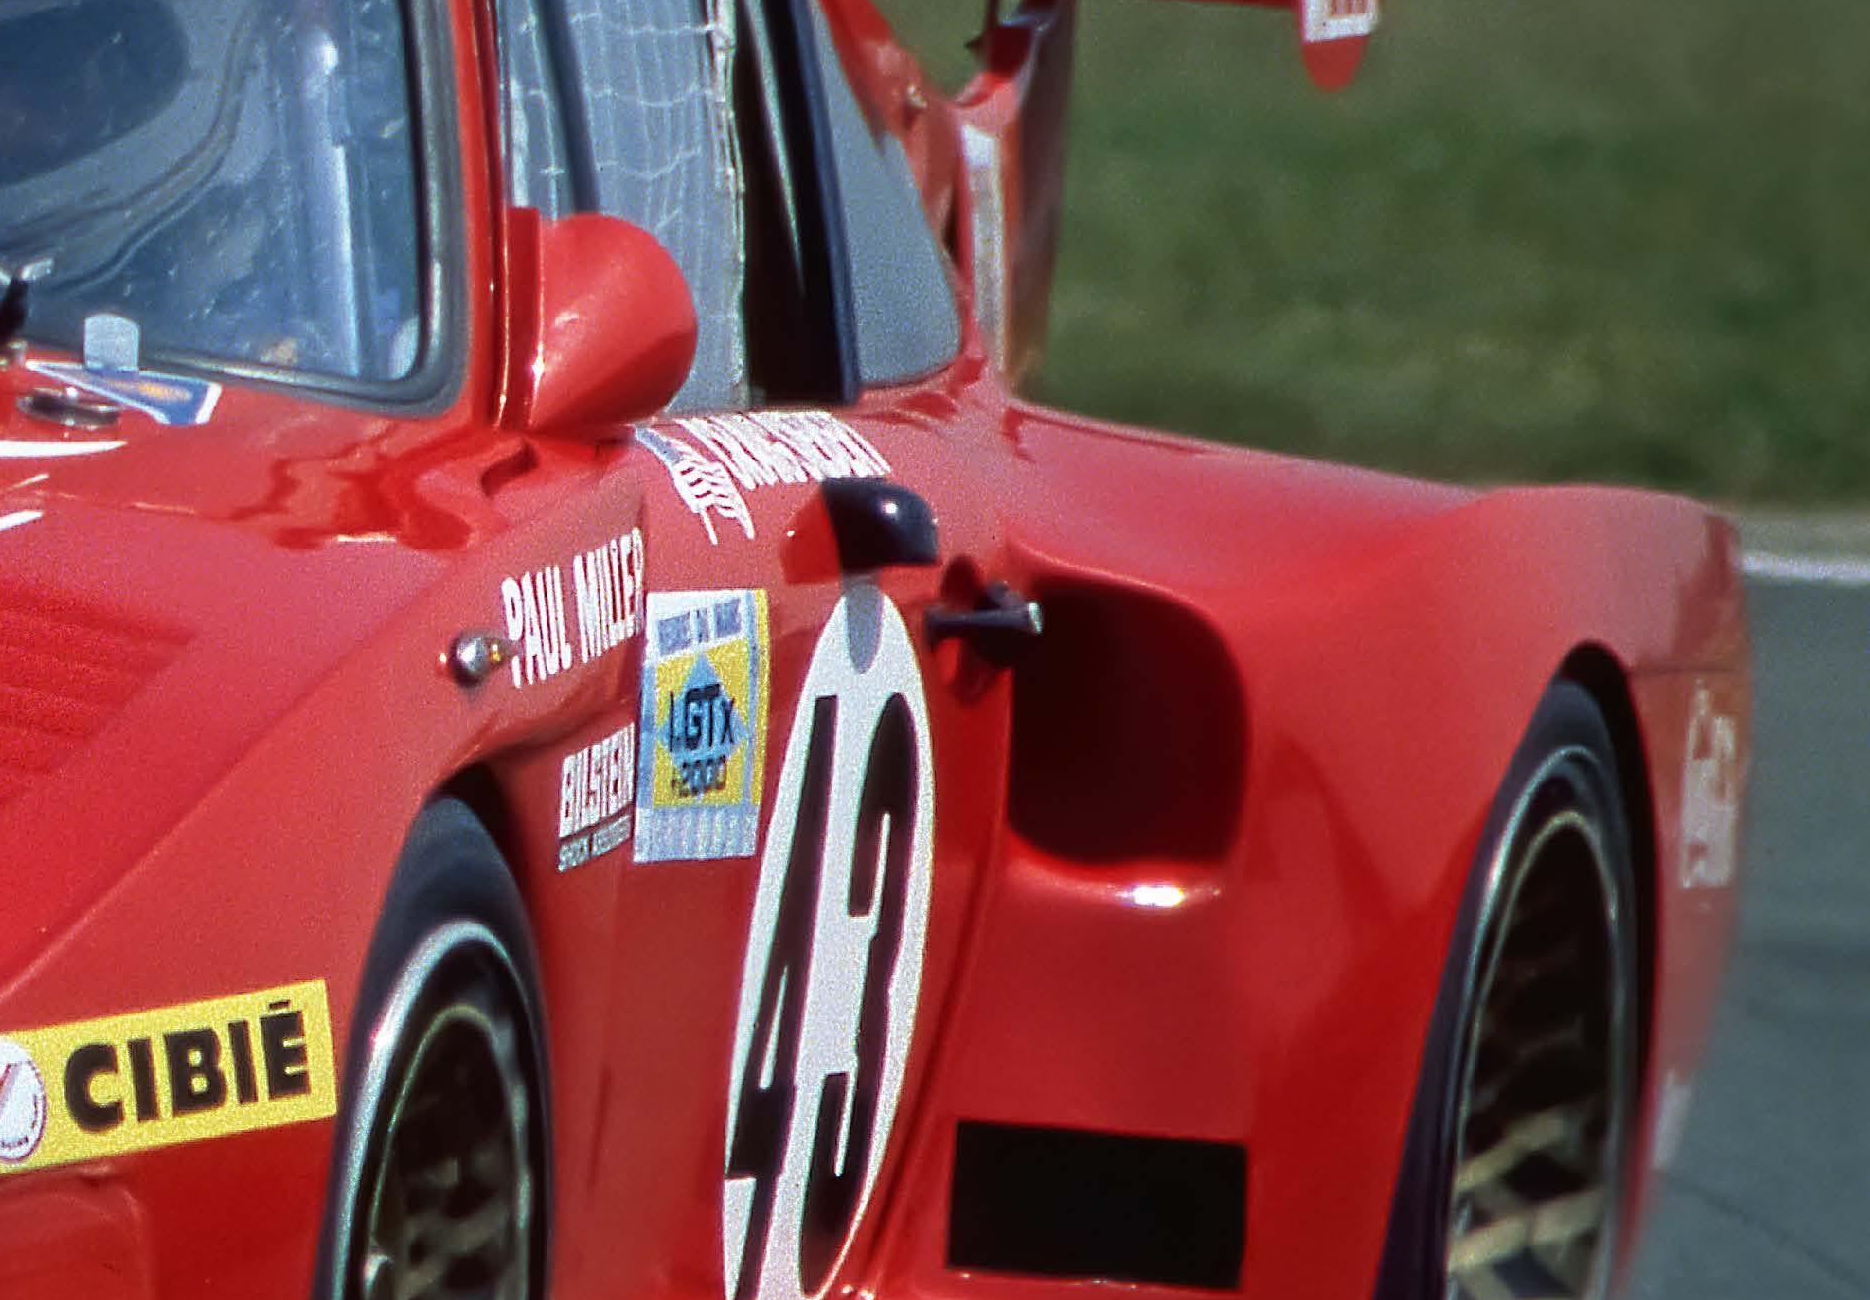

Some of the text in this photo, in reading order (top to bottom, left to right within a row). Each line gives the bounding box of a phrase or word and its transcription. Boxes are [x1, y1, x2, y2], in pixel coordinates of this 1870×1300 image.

[501, 526, 645, 689] PAUL MILLER
[558, 722, 636, 839] BILSTEIN
[63, 999, 311, 1132] CIBIÉ
